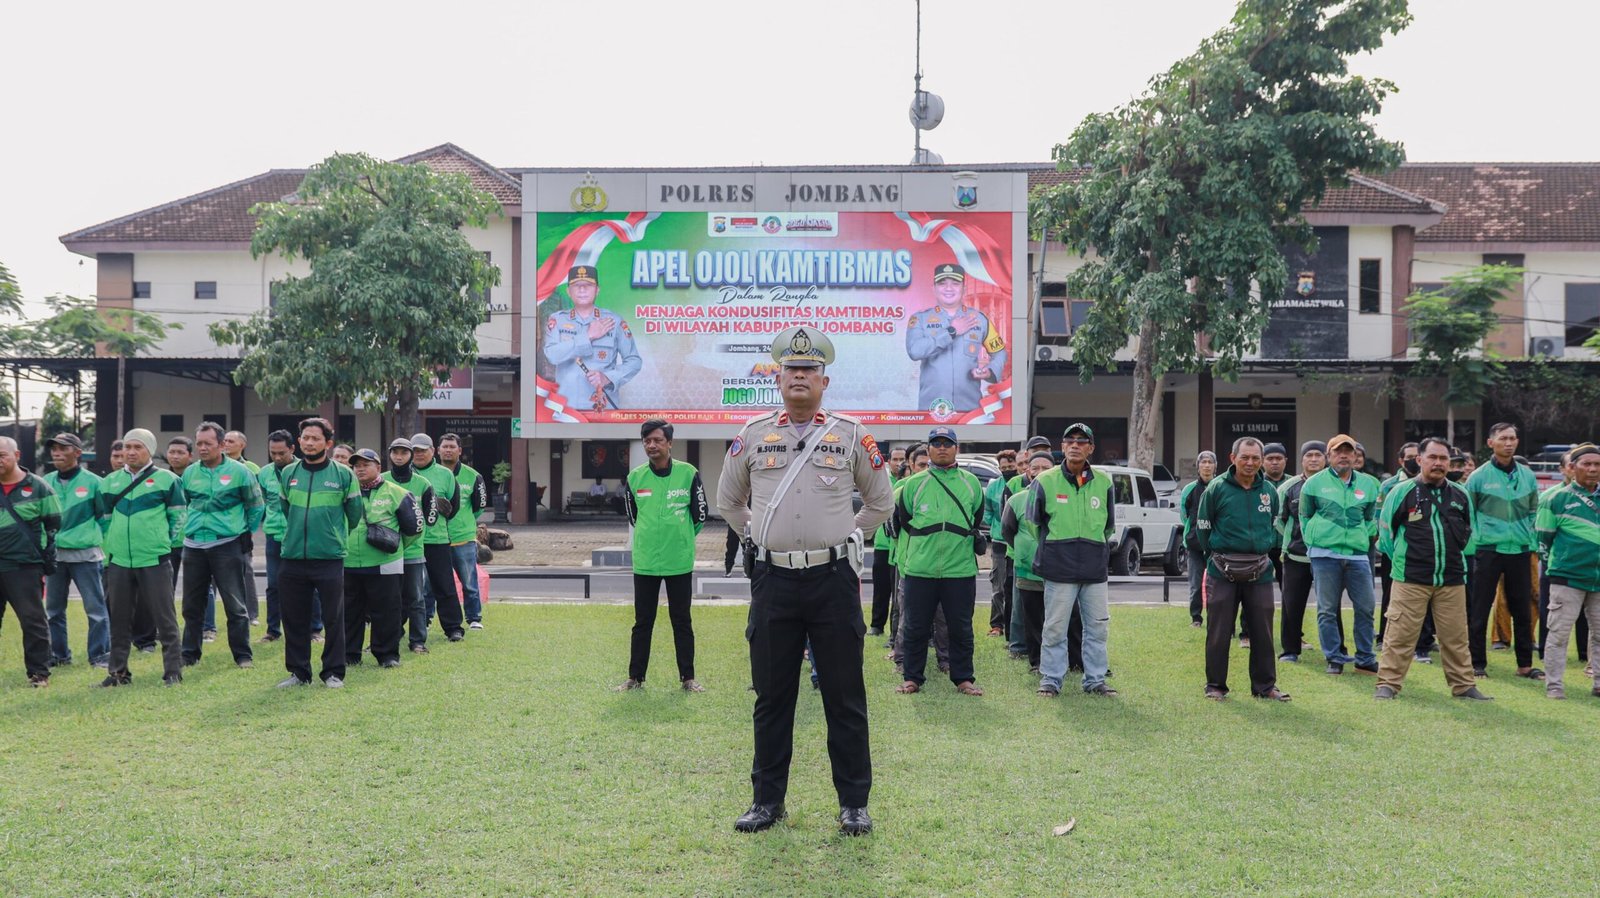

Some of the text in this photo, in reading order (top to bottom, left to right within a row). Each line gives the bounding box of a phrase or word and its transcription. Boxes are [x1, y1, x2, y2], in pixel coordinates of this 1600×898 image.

[660, 184, 900, 203] POLRES JOMBANG
[632, 249, 913, 288] APEL OJOL KAMTIBMAS
[718, 286, 764, 304] Dalam
[636, 306, 904, 319] MENJAGA KONDUSIFITAS KAMTIBMAS
[646, 321, 660, 333] DI
[664, 321, 729, 333] WILAYAH
[821, 321, 894, 333] JOMBANG
[722, 387, 756, 405] JOGO
[814, 445, 846, 455] POLRI
[696, 484, 707, 522] gojek
[1258, 505, 1271, 513] Gra
[411, 502, 424, 533] gojek
